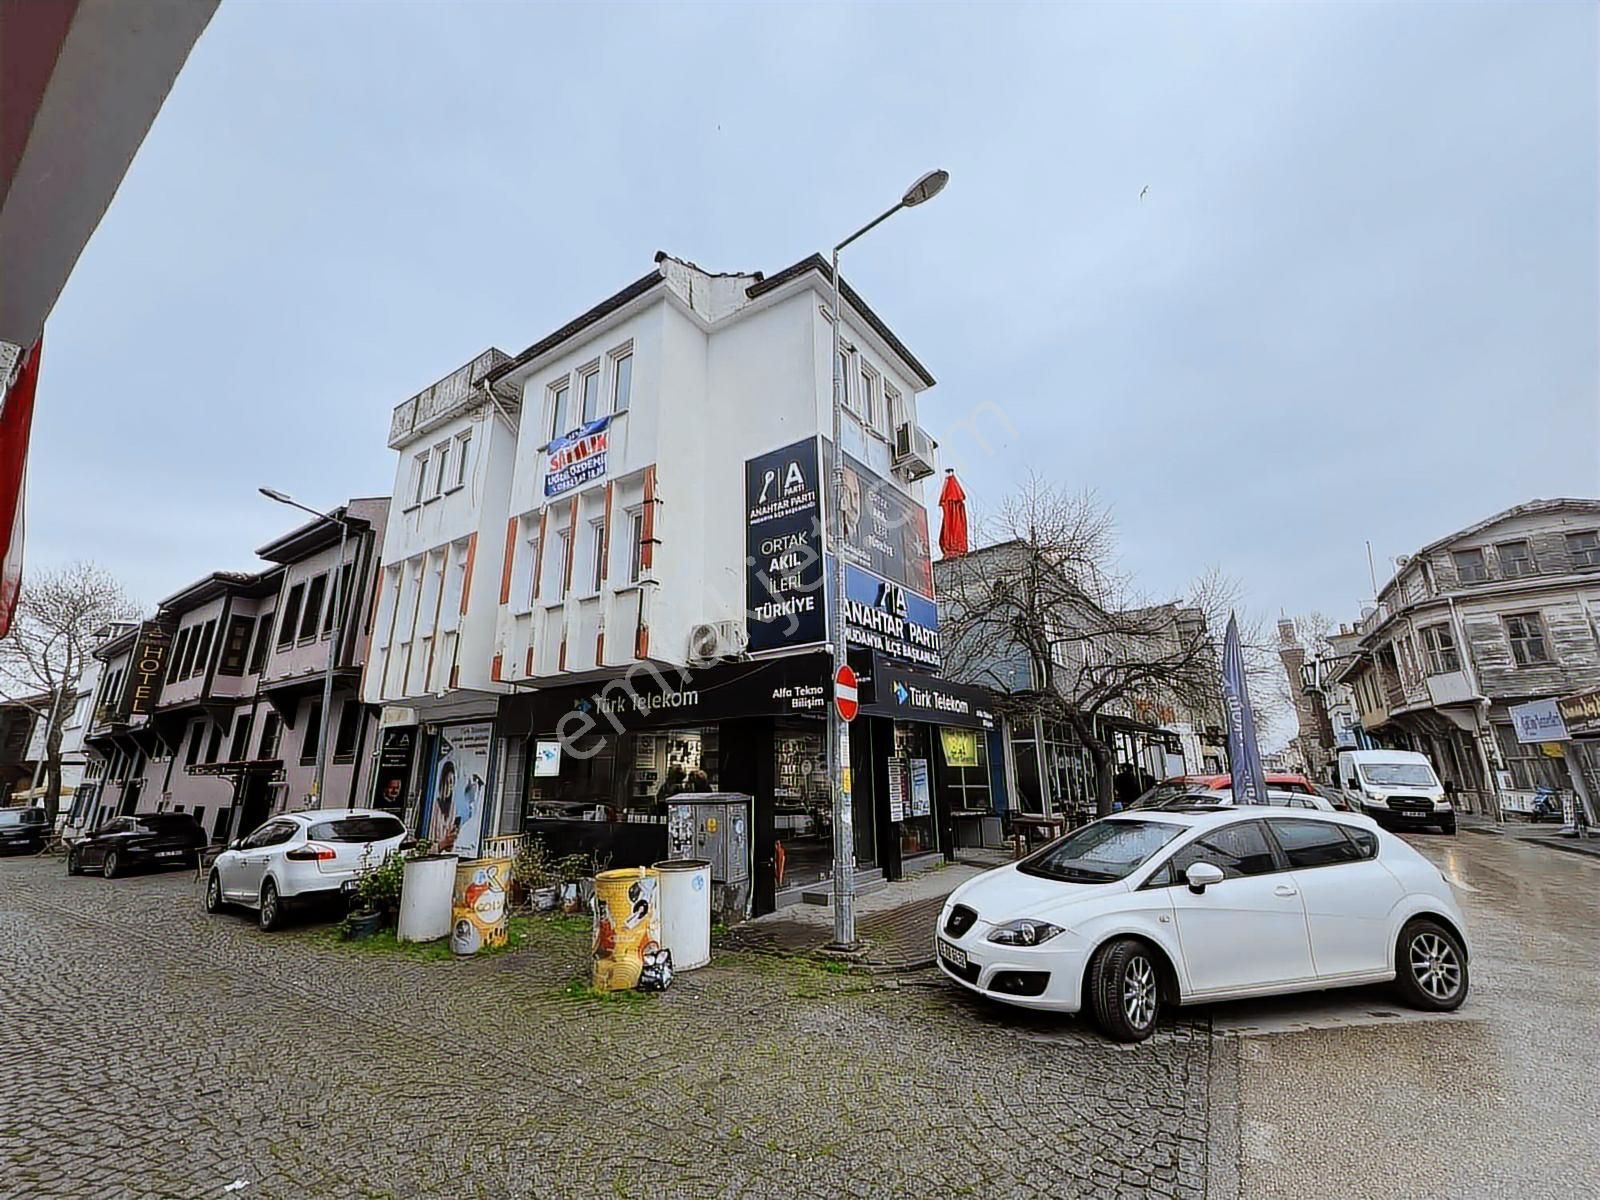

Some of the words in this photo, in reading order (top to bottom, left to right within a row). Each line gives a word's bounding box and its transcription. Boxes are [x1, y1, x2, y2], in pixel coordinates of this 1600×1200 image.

[783, 462, 804, 489] A
[750, 499, 789, 518] ANAHTAR
[761, 531, 808, 555] ORTAK
[769, 552, 801, 572] AKIL
[769, 571, 801, 594] İLERİ
[754, 595, 815, 621] TÜRKİYE
[844, 599, 904, 639] ANAHTAR
[132, 645, 163, 713] HOTEL
[595, 696, 626, 715] Türk
[631, 690, 699, 711] Telekom
[772, 687, 792, 699] Alfa
[793, 685, 824, 697] Tekno
[791, 696, 824, 709] Bilişim
[909, 686, 932, 708] Türk
[933, 691, 969, 714] Telekom
